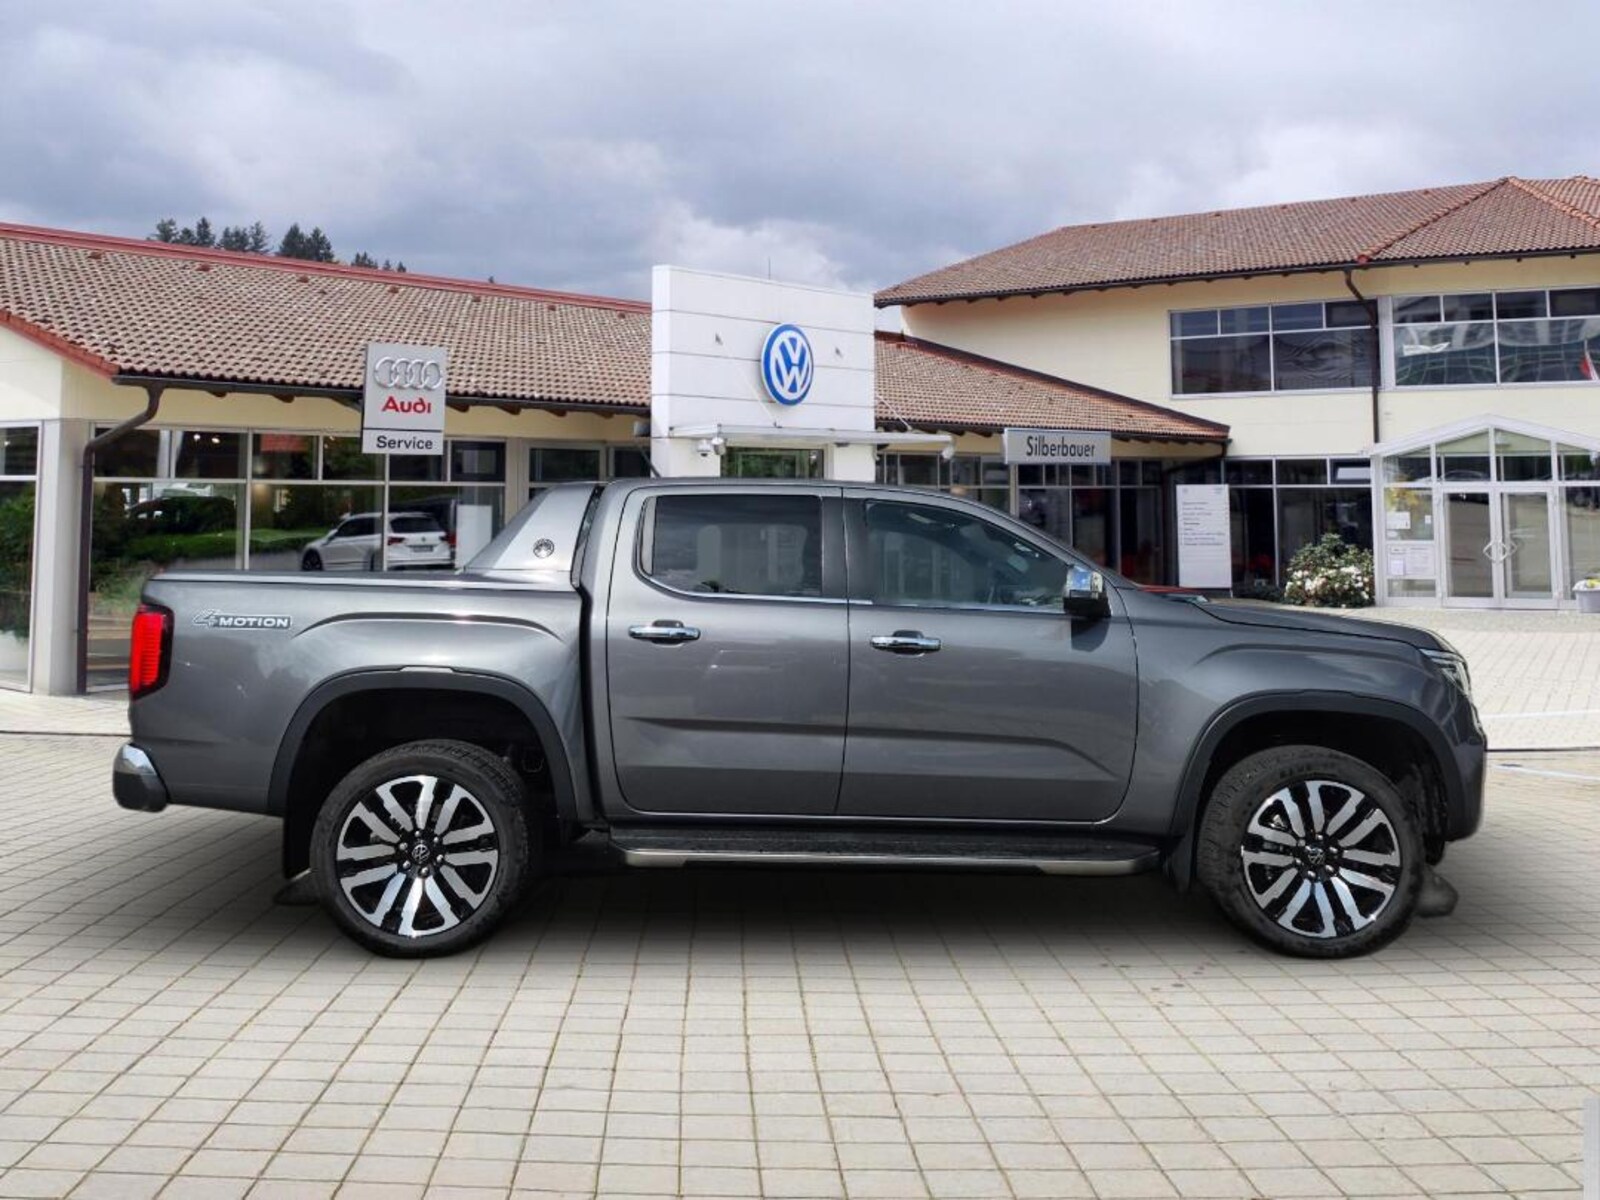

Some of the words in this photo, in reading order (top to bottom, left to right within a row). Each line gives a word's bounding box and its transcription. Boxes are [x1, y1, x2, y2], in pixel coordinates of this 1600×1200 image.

[382, 396, 432, 414] Audi
[376, 435, 433, 450] Service
[1026, 435, 1096, 458] Silberbauer
[193, 609, 289, 629] 4MOTION
